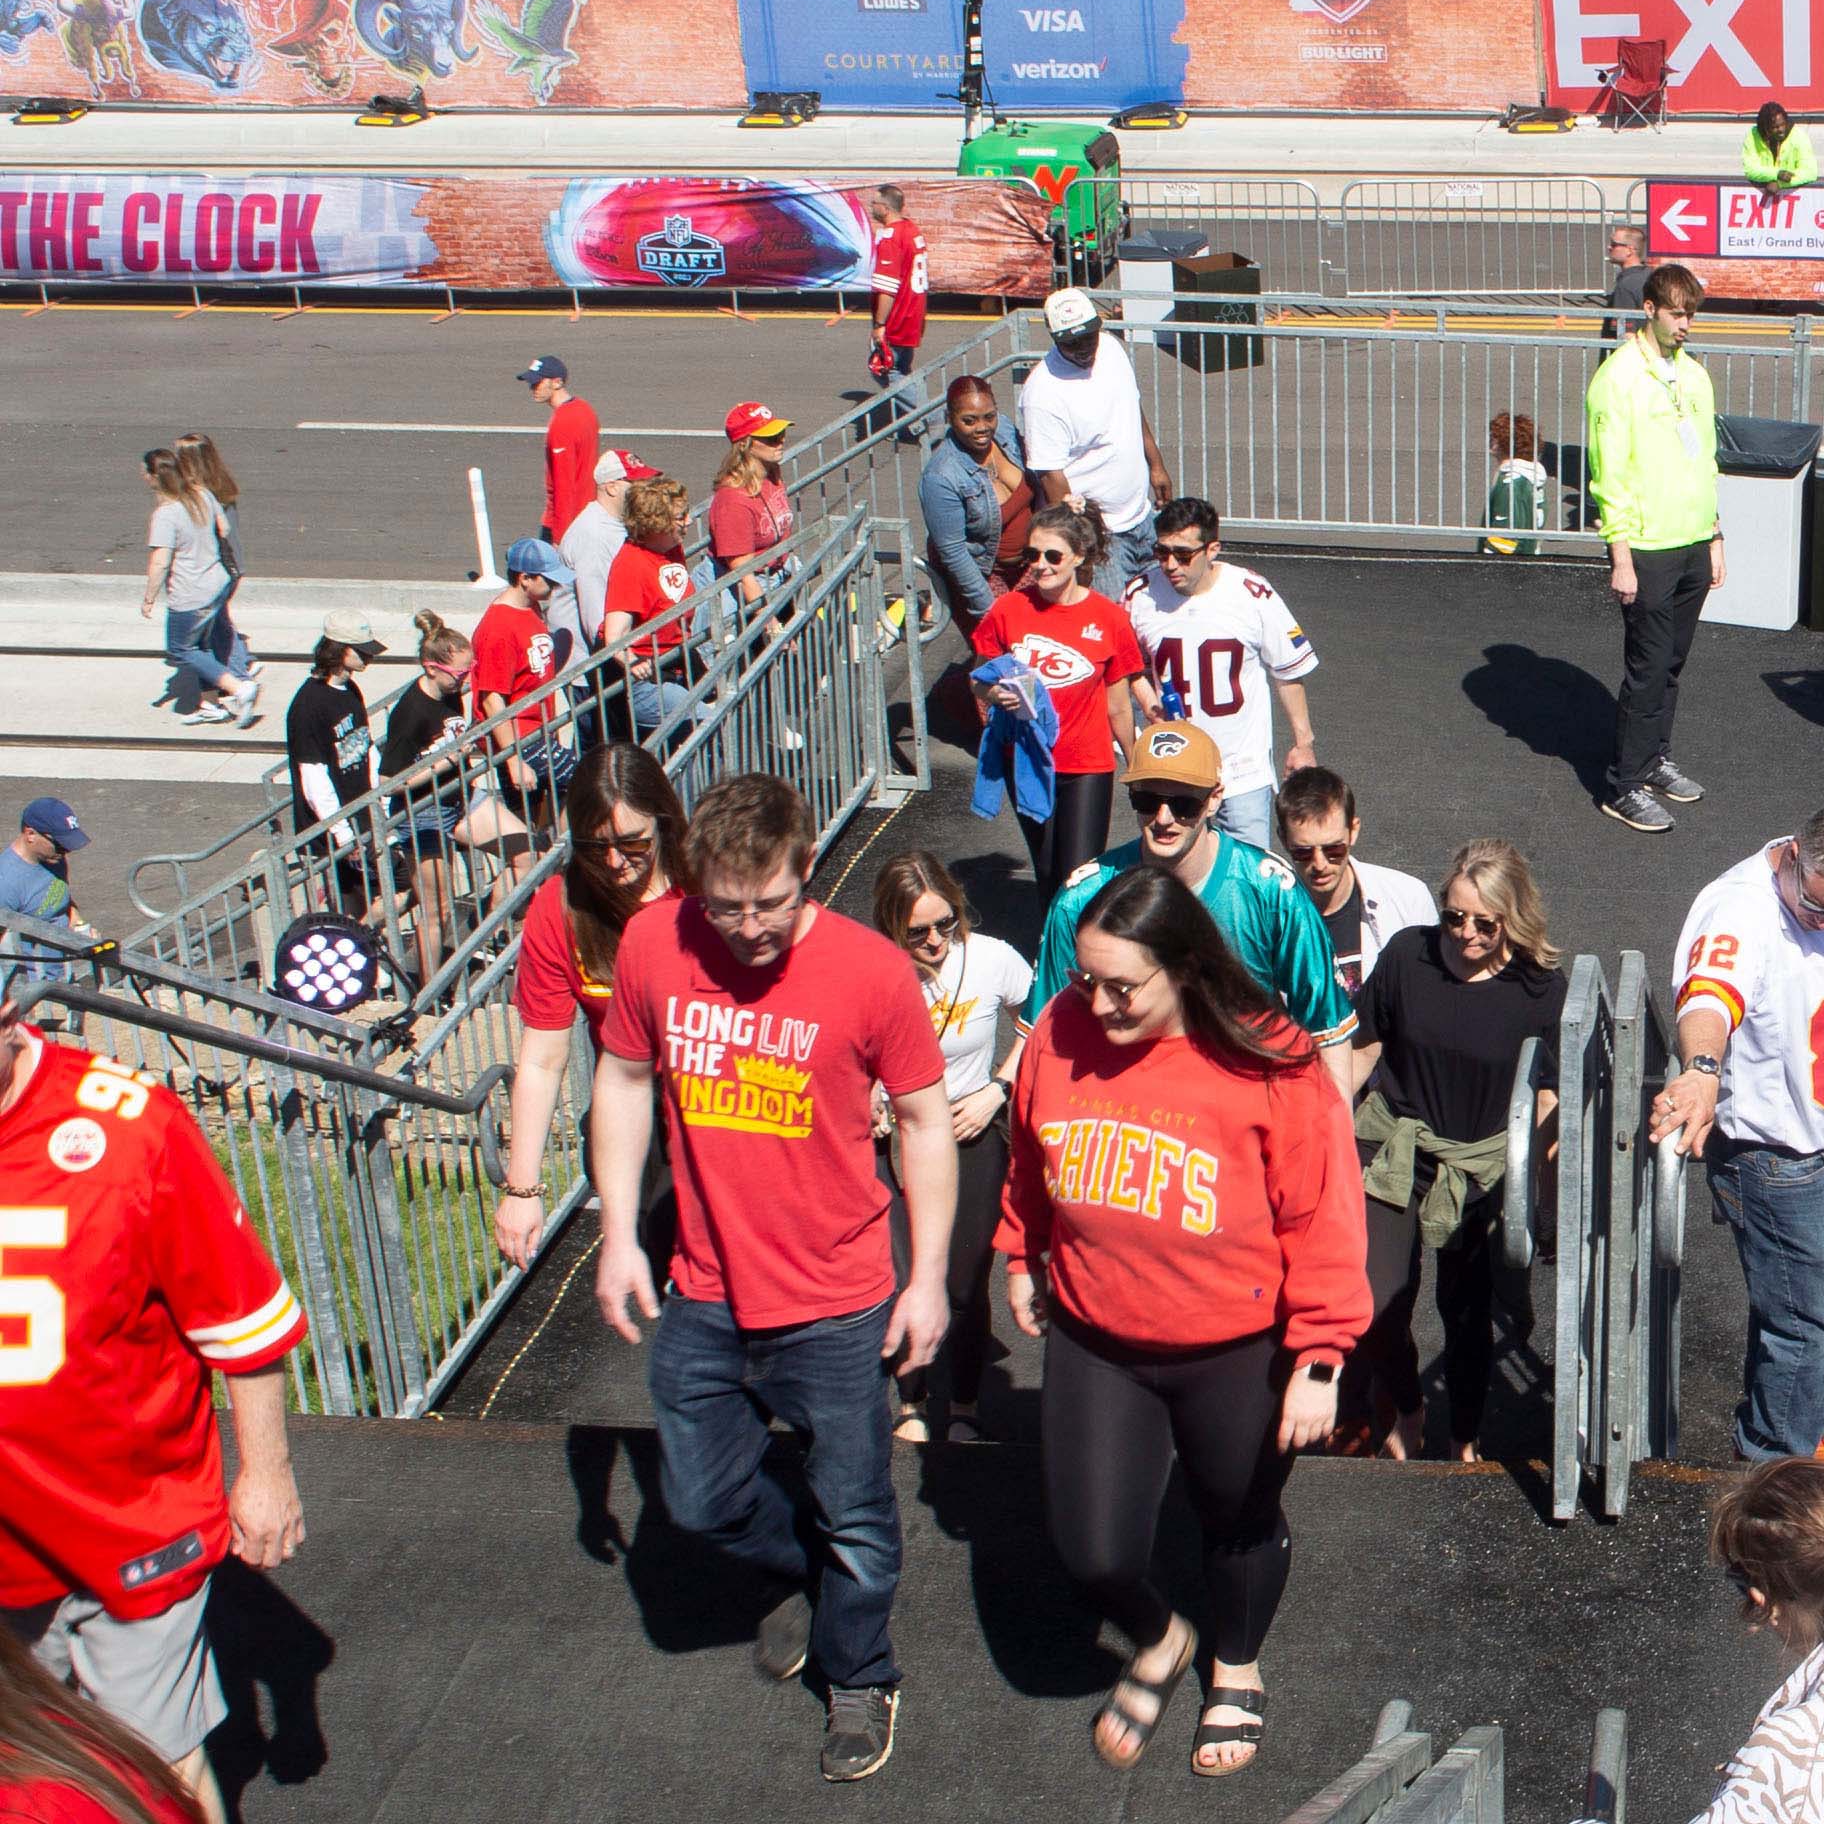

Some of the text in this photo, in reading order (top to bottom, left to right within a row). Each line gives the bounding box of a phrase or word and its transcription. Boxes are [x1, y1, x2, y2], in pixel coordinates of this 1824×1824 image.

[1019, 10, 1086, 32] VISA
[1012, 59, 1100, 79] verizon
[1301, 46, 1384, 59] BUD LIGHT
[1728, 194, 1801, 229] EXIT
[0, 192, 323, 273] THE CLOCK
[1728, 236, 1755, 247] East
[1765, 237, 1803, 248] Grand
[644, 251, 718, 268] DRAFT
[1155, 637, 1246, 718] 40
[1686, 933, 1741, 972] 82
[665, 996, 820, 1062] LONG LIV
[664, 1034, 727, 1077] THE
[672, 1072, 814, 1126] INGDOM
[1150, 1107, 1198, 1129] CITY
